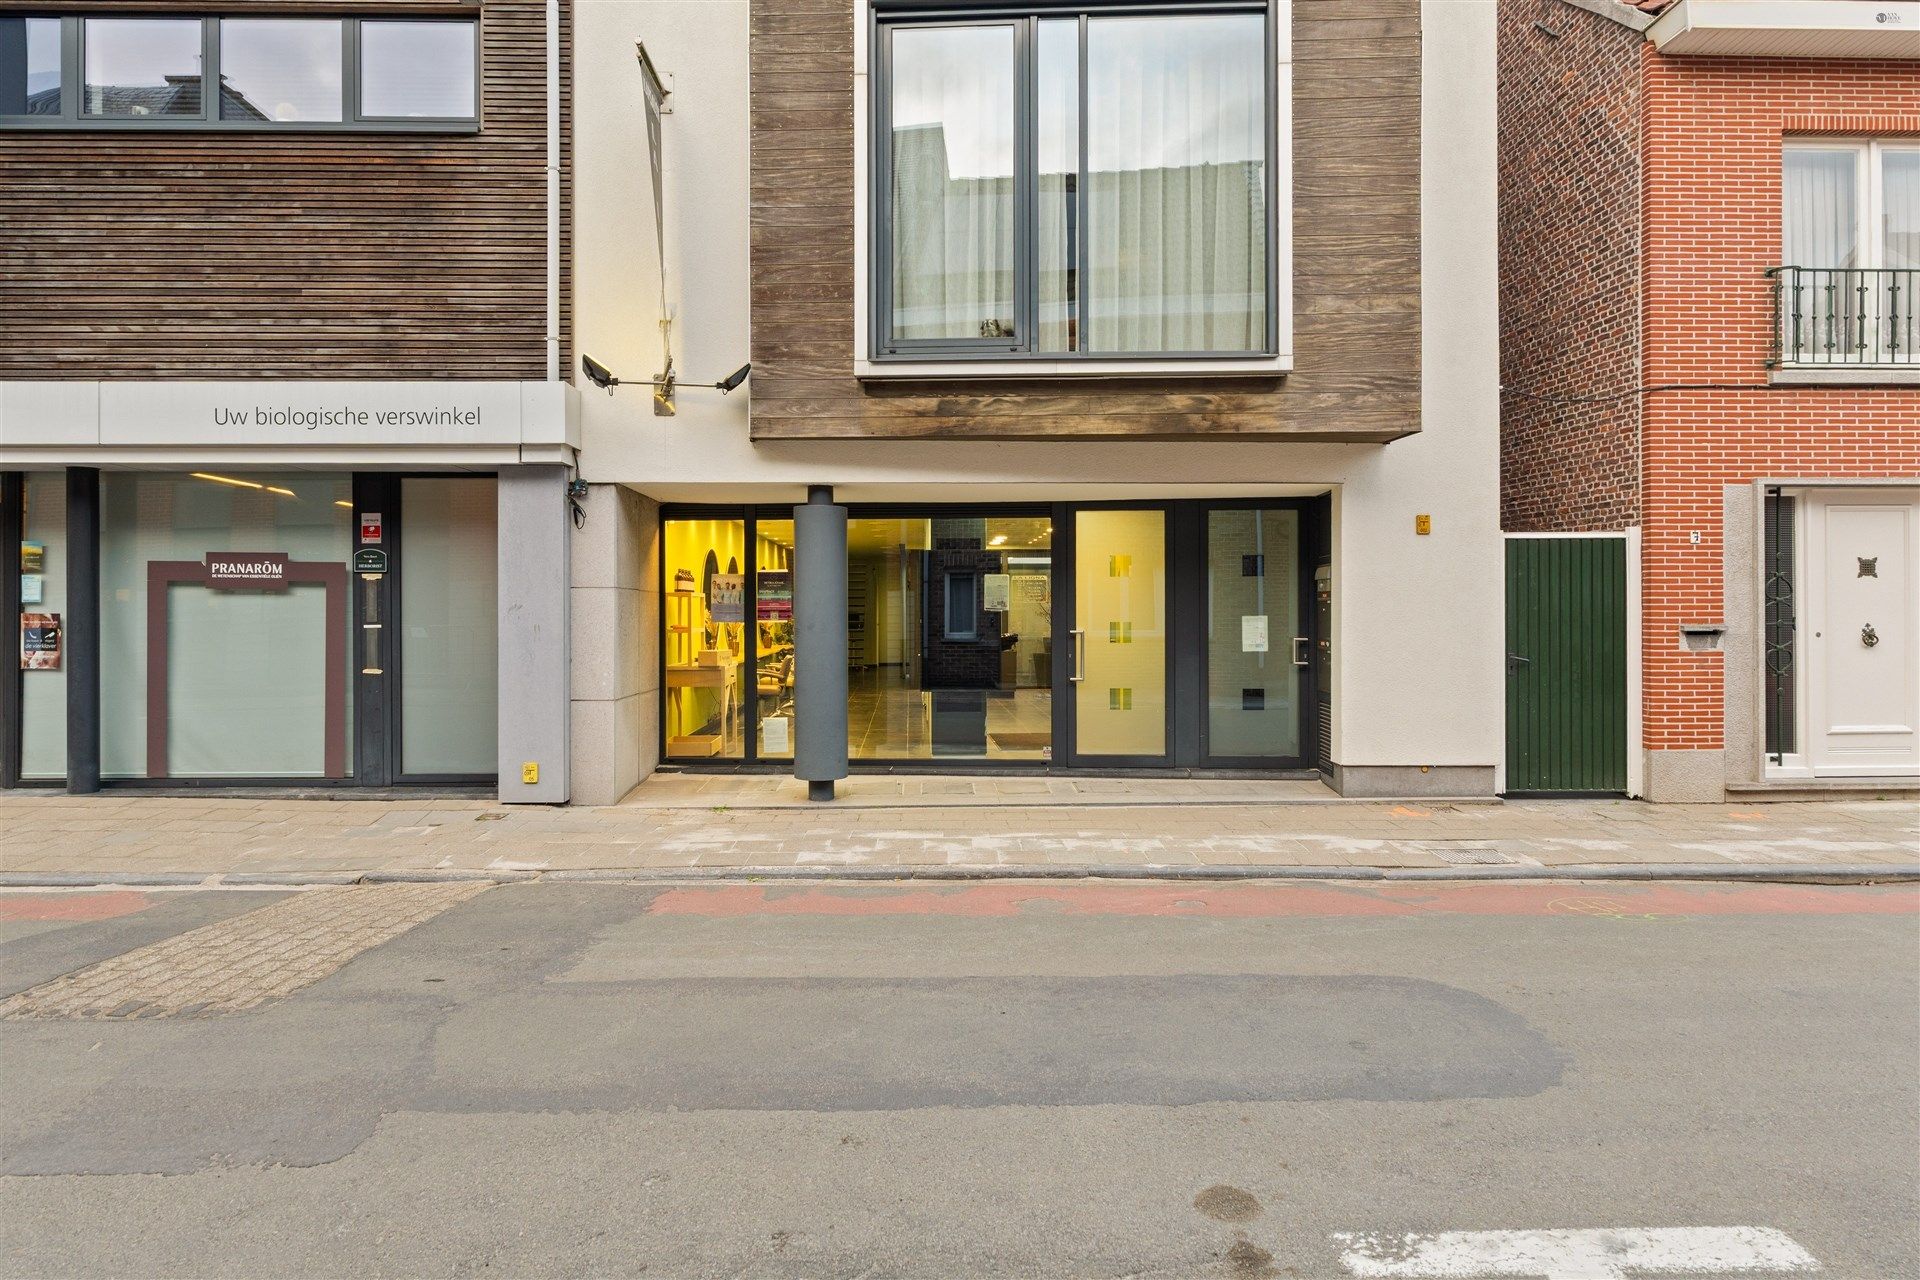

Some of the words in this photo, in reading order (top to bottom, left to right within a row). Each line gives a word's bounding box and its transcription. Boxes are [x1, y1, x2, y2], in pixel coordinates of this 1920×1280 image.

[214, 407, 248, 425] Uw
[255, 406, 369, 430] biologische
[376, 406, 481, 425] verswinkel
[211, 561, 283, 574] PRANARŌM
